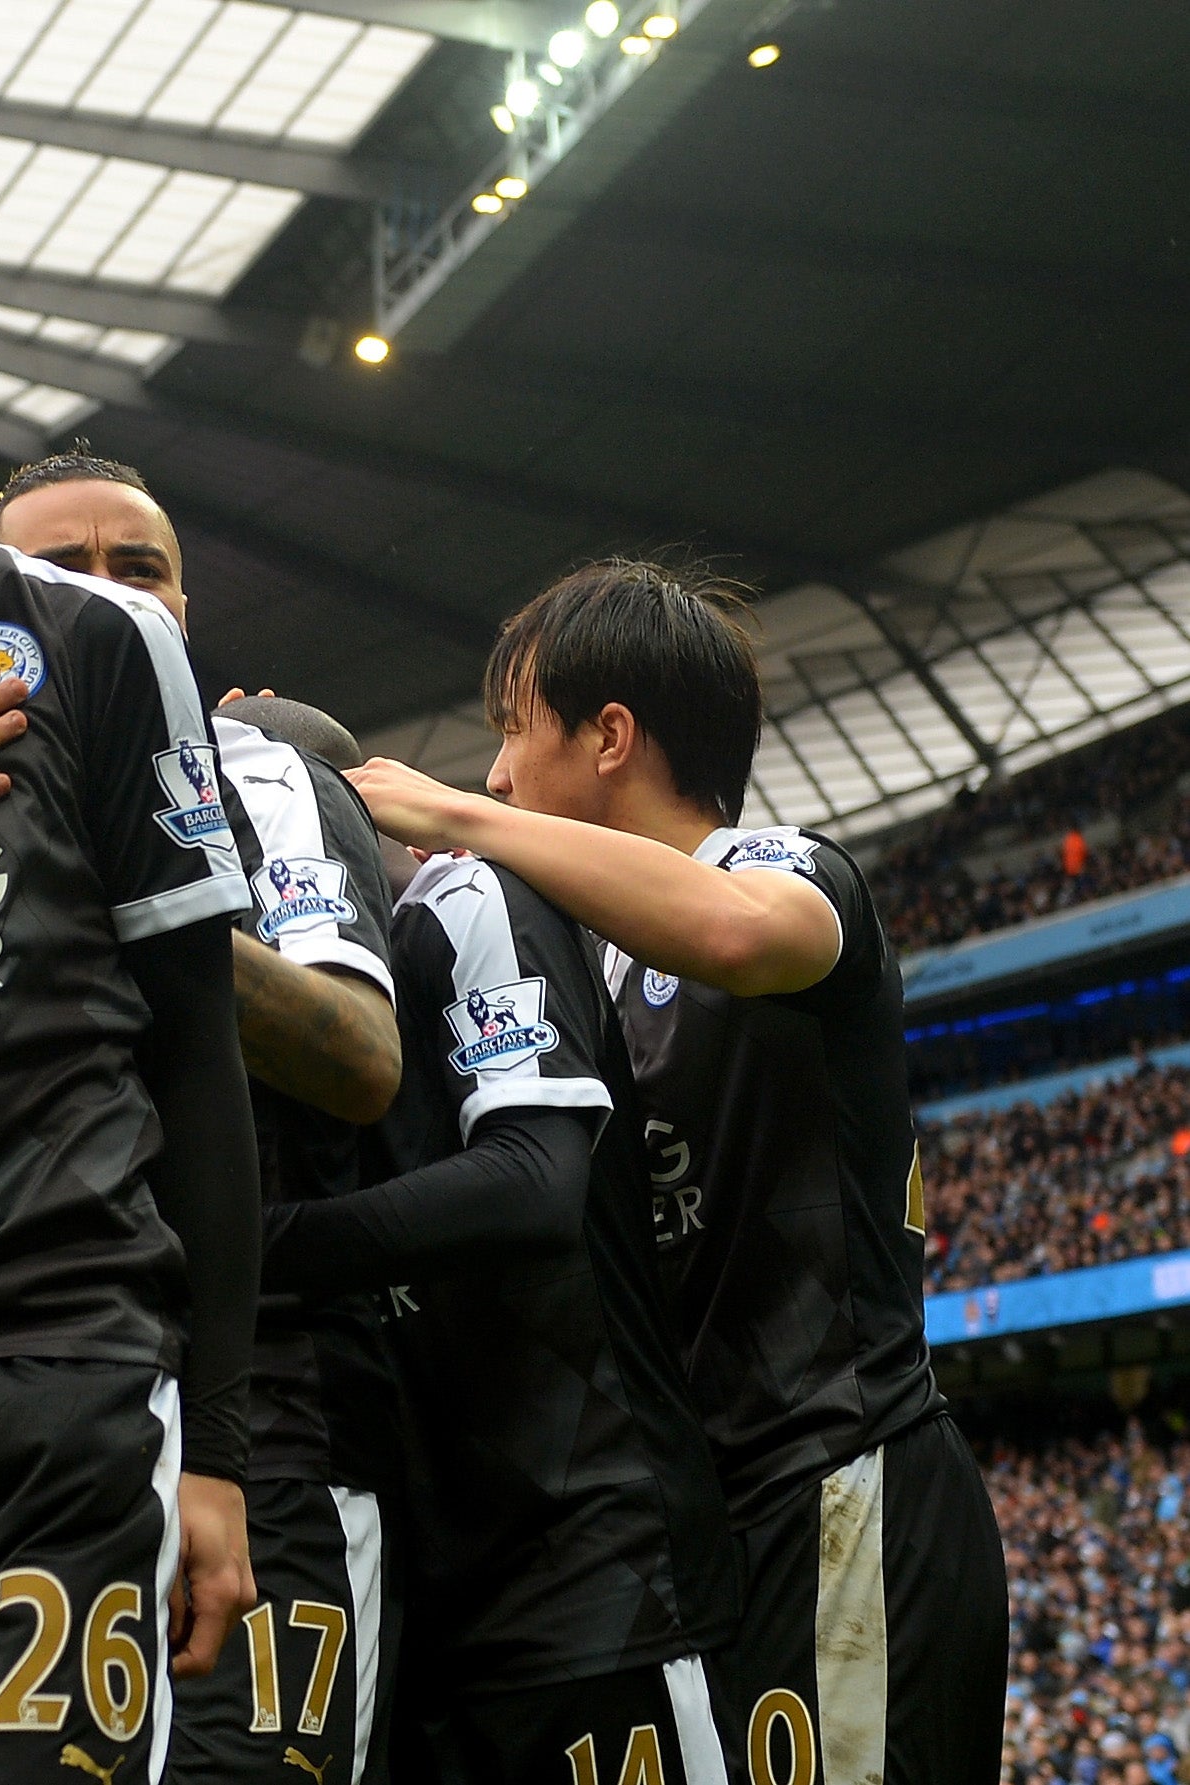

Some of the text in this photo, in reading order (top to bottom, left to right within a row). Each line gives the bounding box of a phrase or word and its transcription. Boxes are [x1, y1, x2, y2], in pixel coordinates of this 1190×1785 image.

[19, 636, 40, 661] CITY
[465, 1030, 527, 1058] BARCLAYS
[241, 1600, 348, 1736] 17
